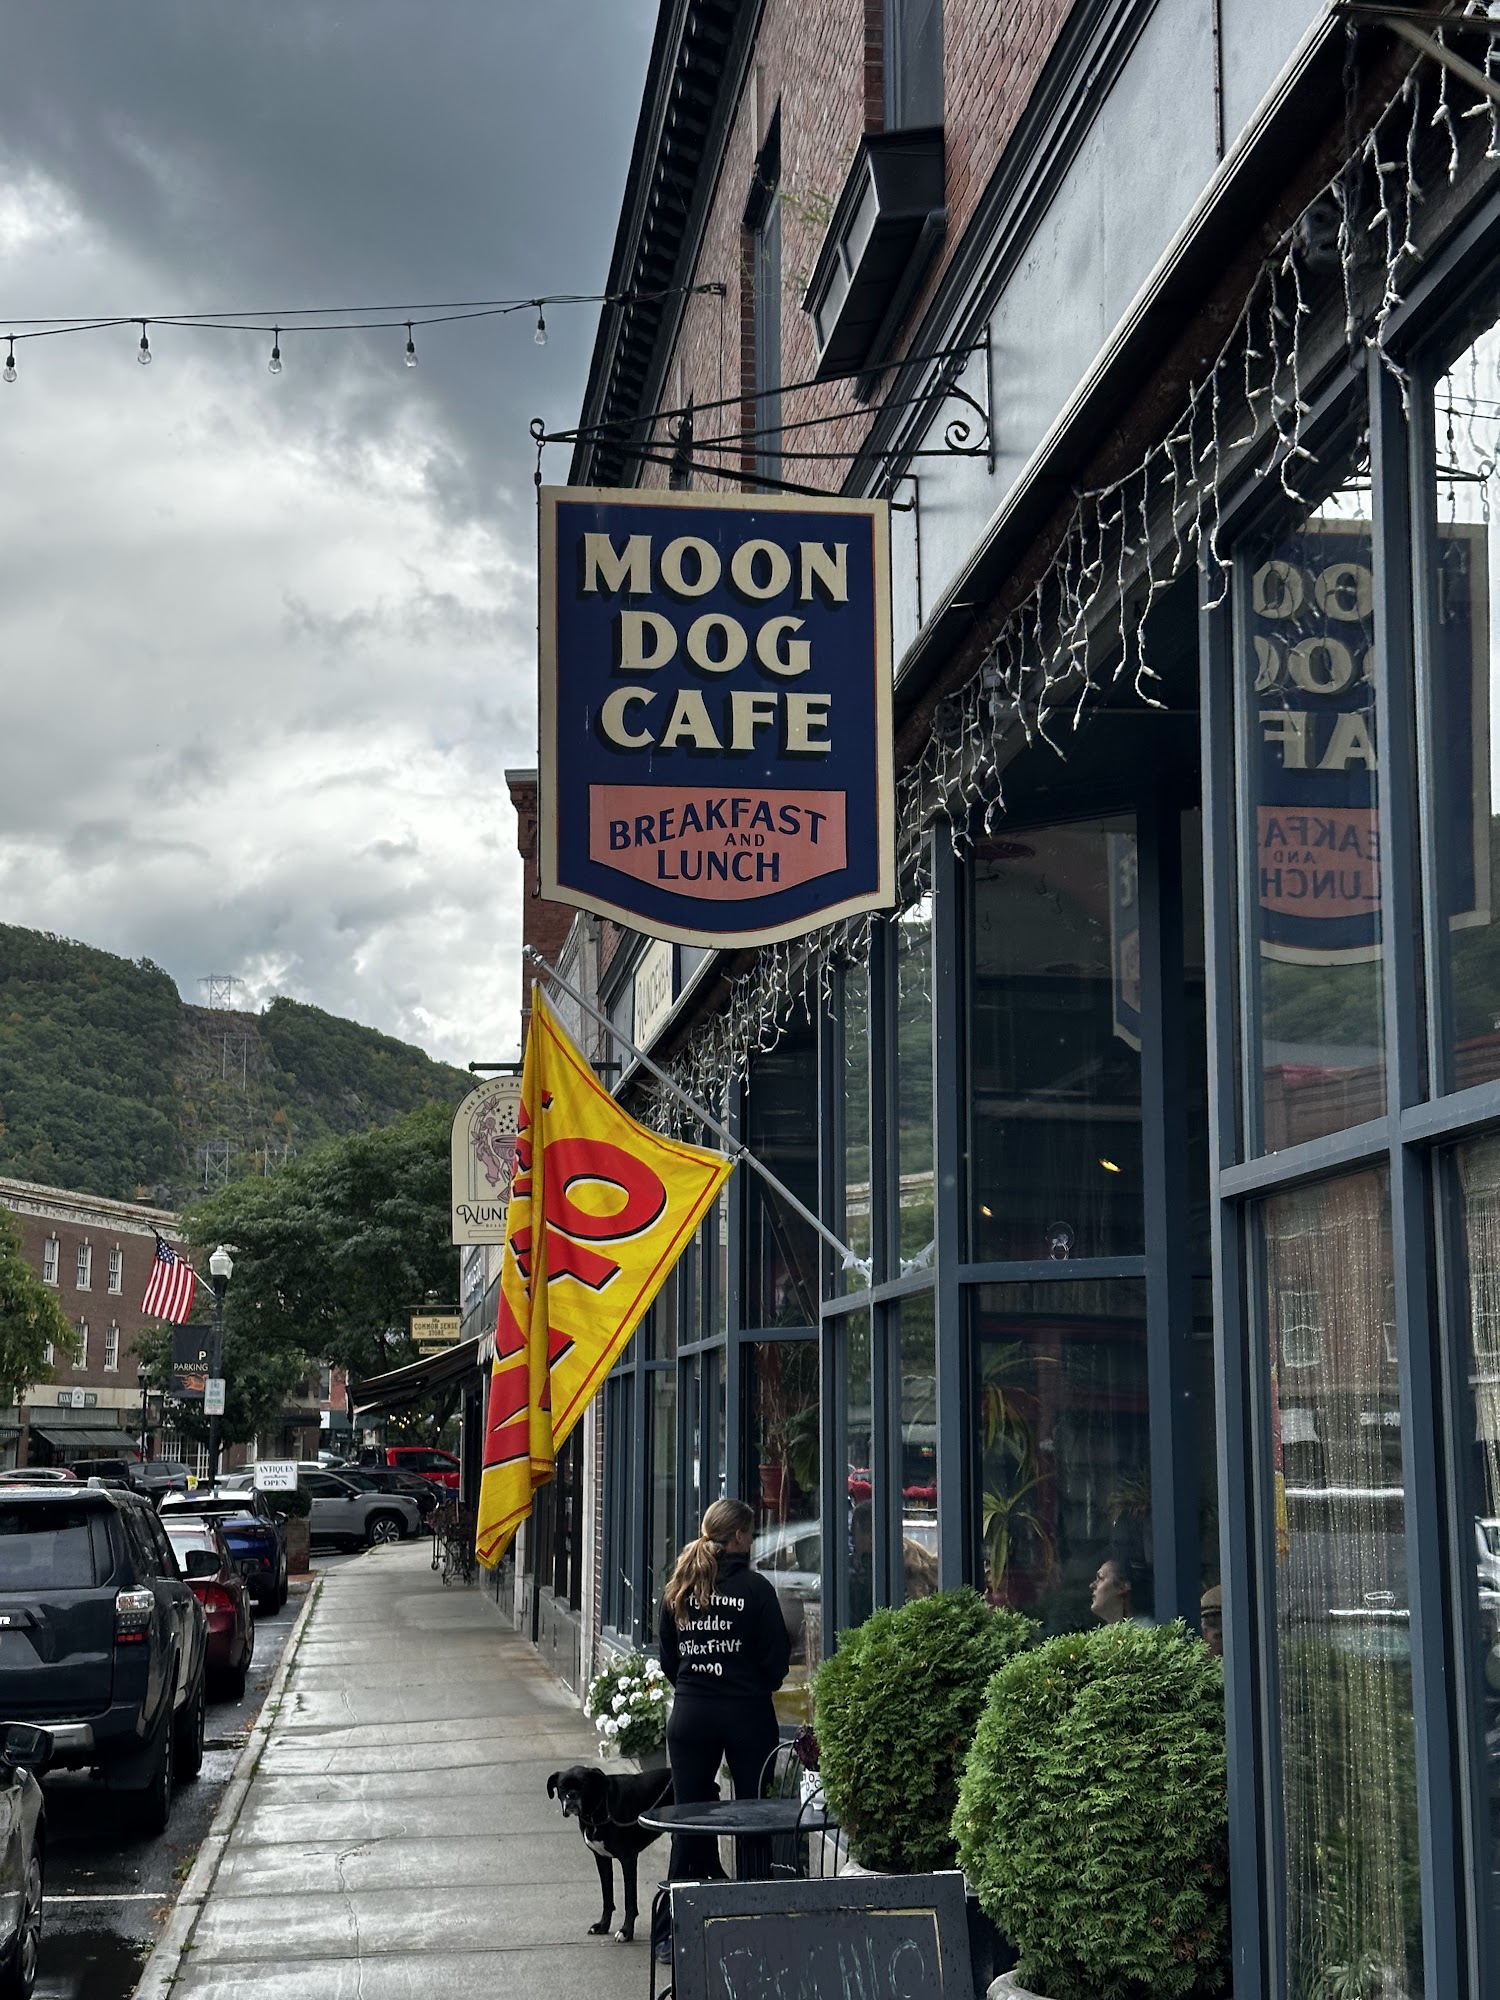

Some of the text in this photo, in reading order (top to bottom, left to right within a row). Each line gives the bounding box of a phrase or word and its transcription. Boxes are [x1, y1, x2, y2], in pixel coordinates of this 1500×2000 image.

[582, 532, 849, 602] MOON
[619, 610, 812, 676] DOG
[600, 686, 832, 752] CAFE
[609, 797, 827, 851] BREAKFAST
[725, 832, 765, 847] AND
[657, 849, 780, 883] LUNCH
[464, 1100, 475, 1115] THE
[477, 1087, 490, 1099] ART
[198, 1350, 207, 1361] P
[173, 1363, 208, 1371] PARKING
[259, 1465, 294, 1473] ANTIQUES
[263, 1479, 287, 1487] OPEN
[679, 1639, 742, 1655] @FlexFitVt
